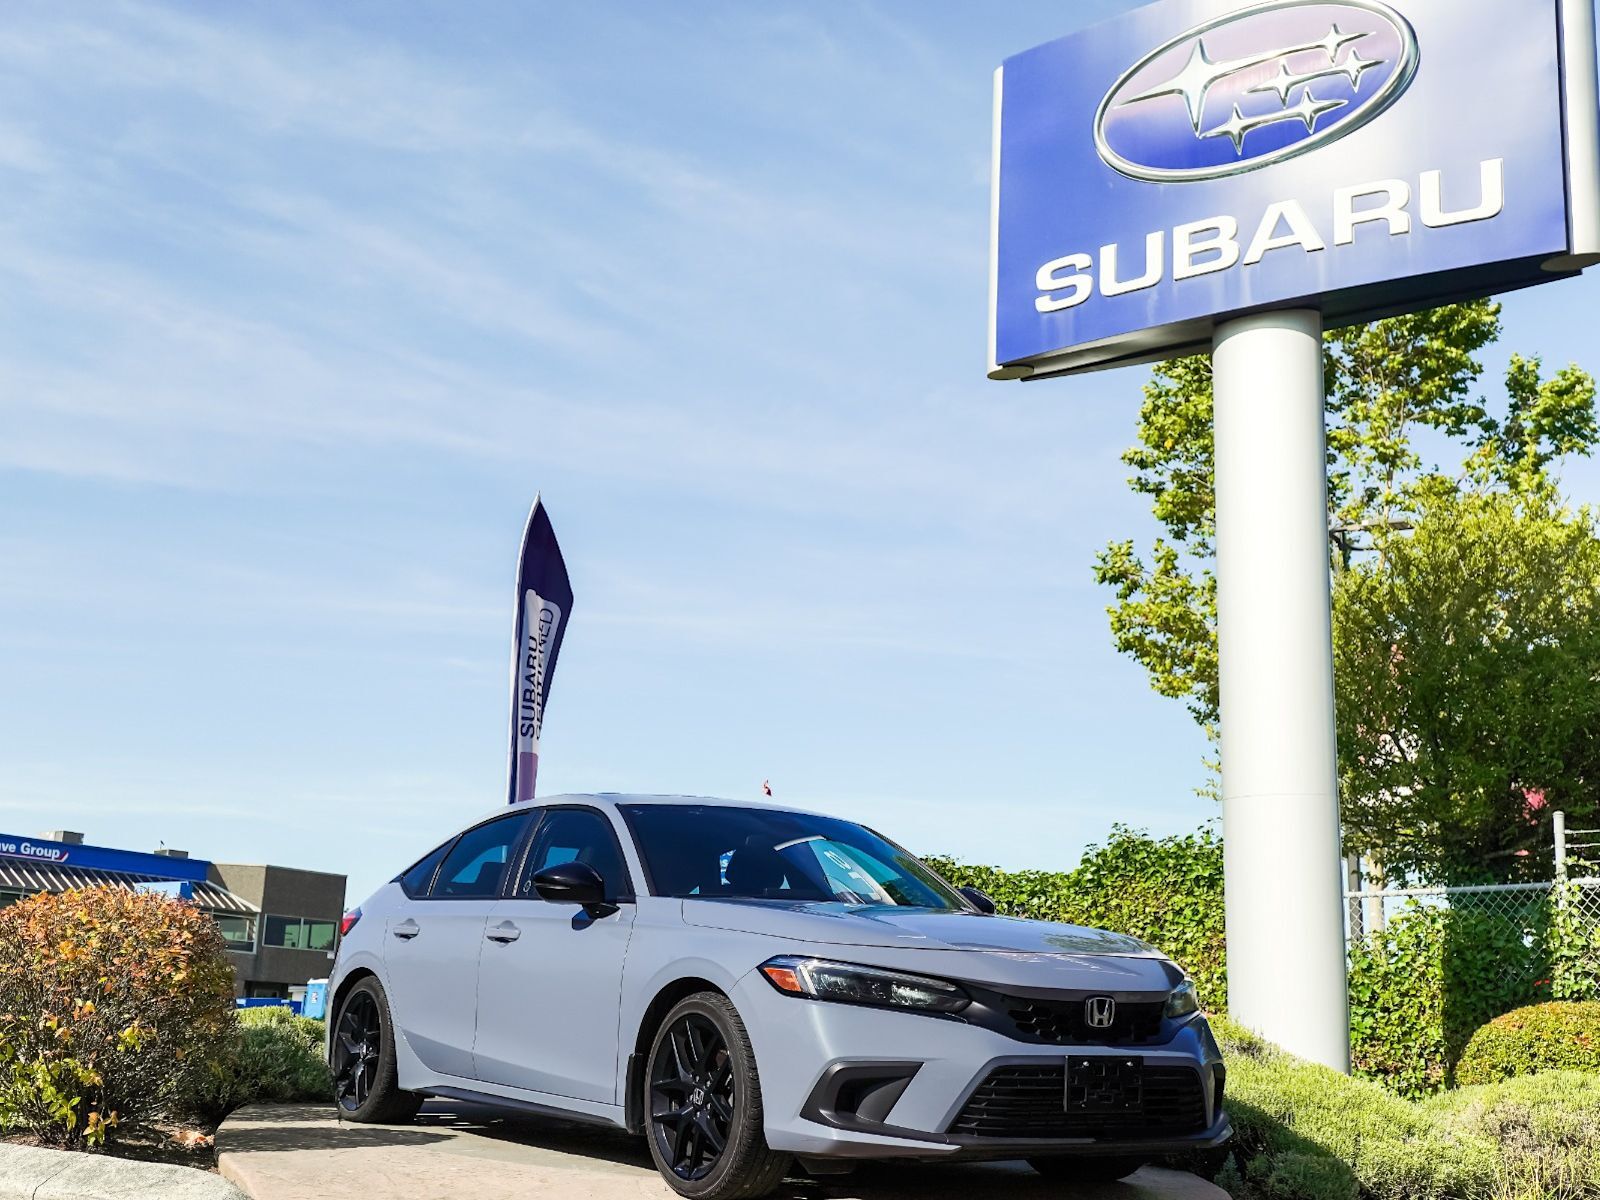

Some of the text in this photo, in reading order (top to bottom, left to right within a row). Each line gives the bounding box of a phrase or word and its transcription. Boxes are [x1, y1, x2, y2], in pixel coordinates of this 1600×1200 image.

[1035, 158, 1504, 313] SUBARU
[521, 636, 537, 739] SUBARU
[0, 842, 60, 860] ve Group
